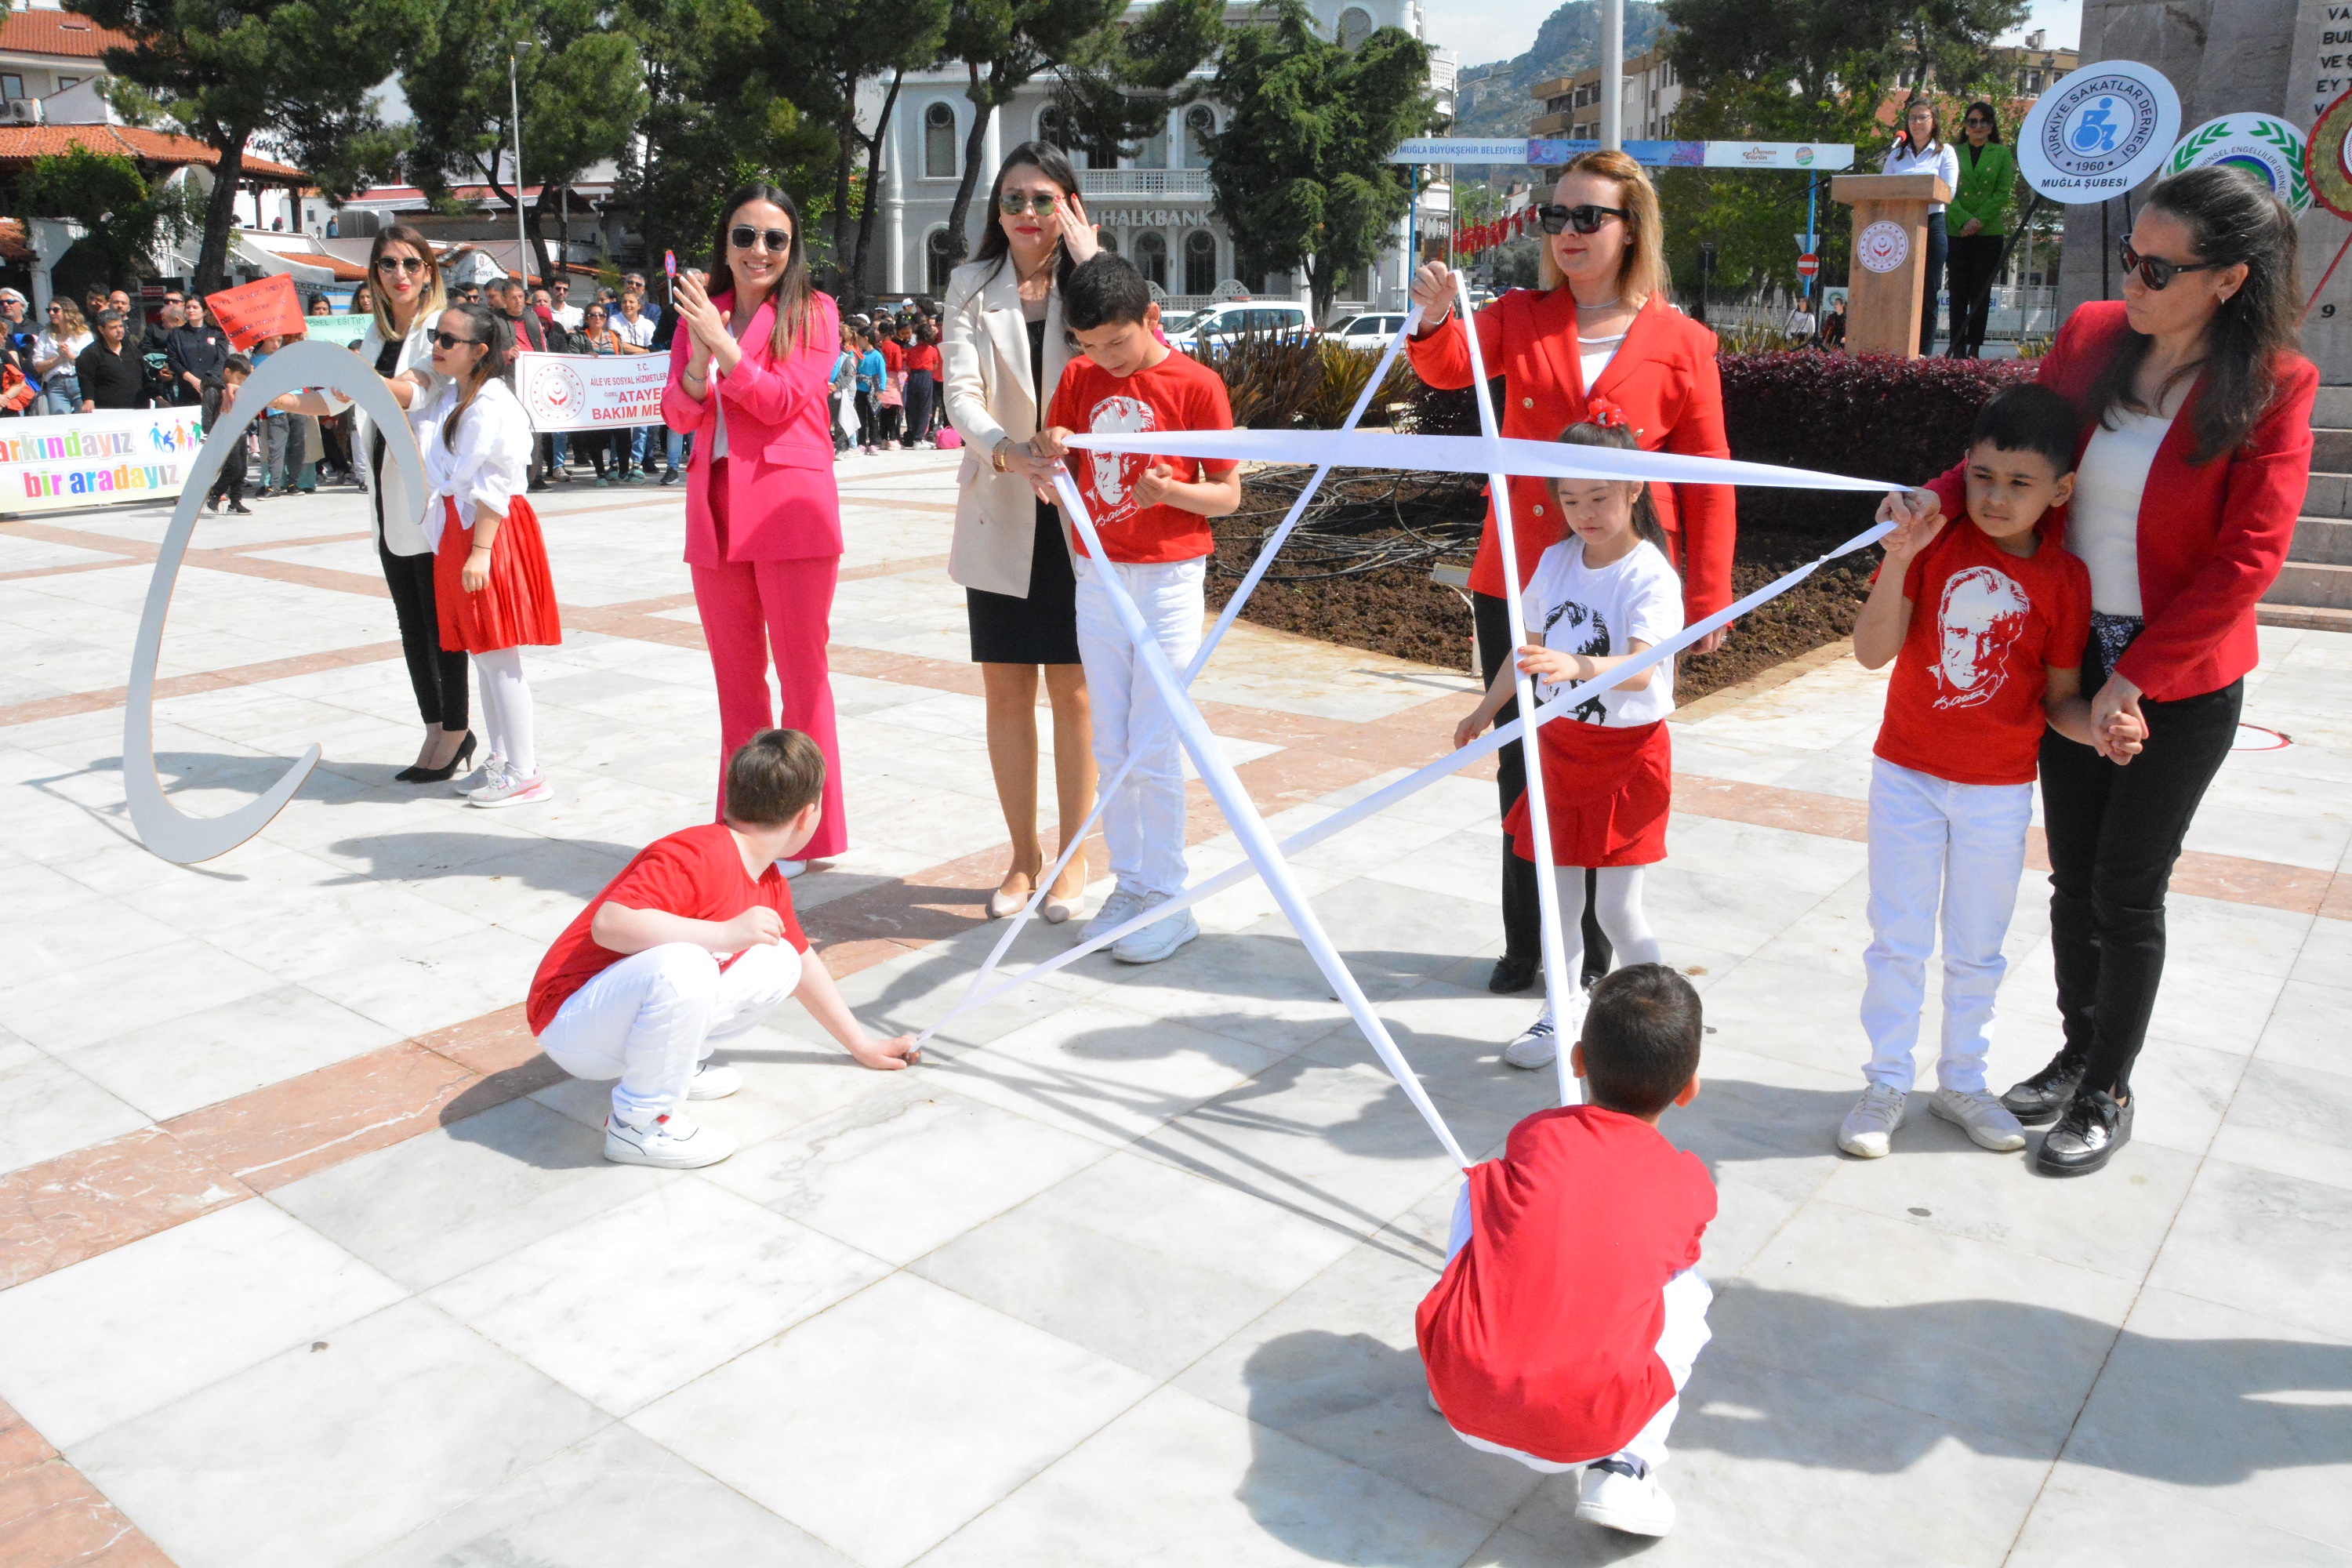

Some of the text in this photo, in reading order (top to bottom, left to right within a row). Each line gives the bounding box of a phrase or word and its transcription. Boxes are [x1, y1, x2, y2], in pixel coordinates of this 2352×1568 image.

[2321, 55, 2343, 69] VE
[2316, 78, 2341, 93] EY
[2049, 80, 2153, 158] TÜRKİYE SAKATLAR DERNEĞİ
[1399, 144, 1525, 156] MUĞLA BÜYÜKŞEHİR BELEDİYESİ
[2075, 161, 2104, 171] 1960
[2041, 176, 2128, 189] MUĞLA ŞUBESİ
[1101, 209, 1212, 227] HALKBANK
[590, 376, 603, 387] AİLE
[612, 376, 635, 386] SOSYAL
[619, 387, 666, 404] ATAYE
[592, 406, 637, 420] BAKIM
[24, 464, 180, 499] bir aradayız
